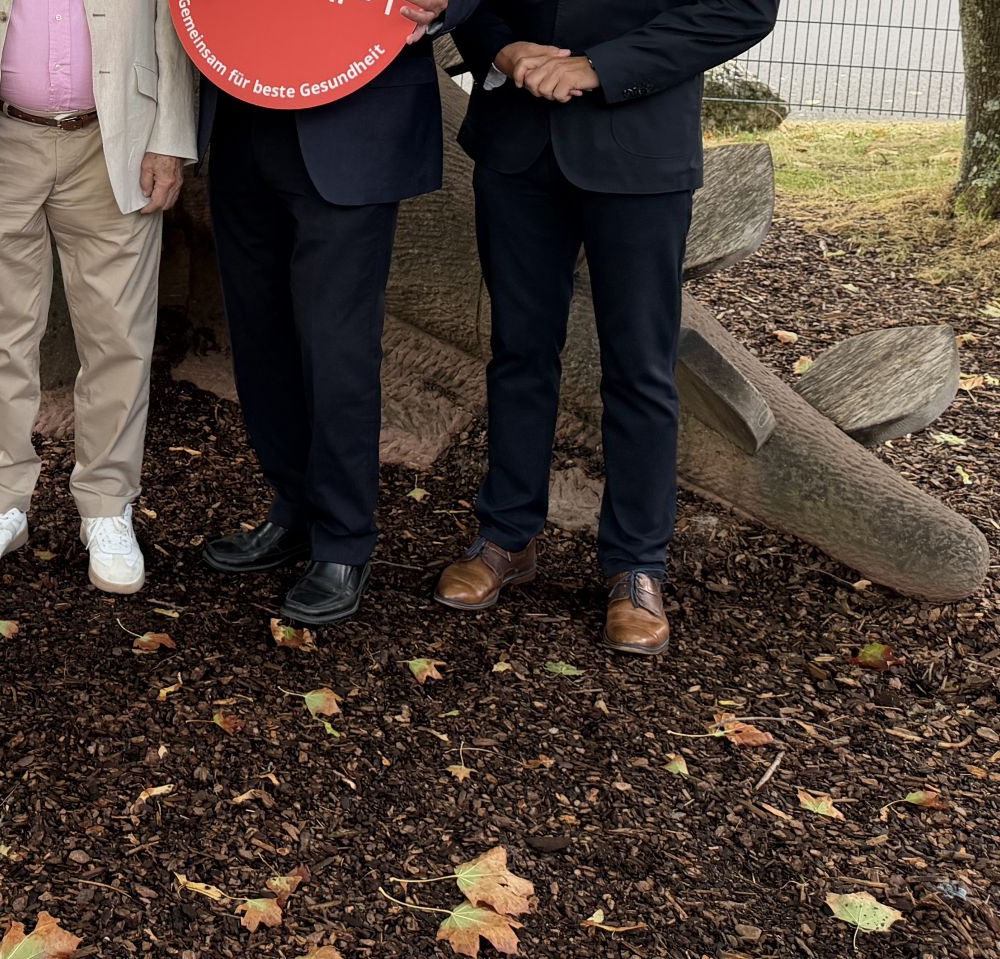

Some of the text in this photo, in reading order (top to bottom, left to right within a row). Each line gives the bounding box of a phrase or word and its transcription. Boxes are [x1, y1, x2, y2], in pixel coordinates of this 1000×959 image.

[228, 69, 251, 89] für
[253, 79, 296, 98] beste
[300, 43, 386, 97] Gesundheit
